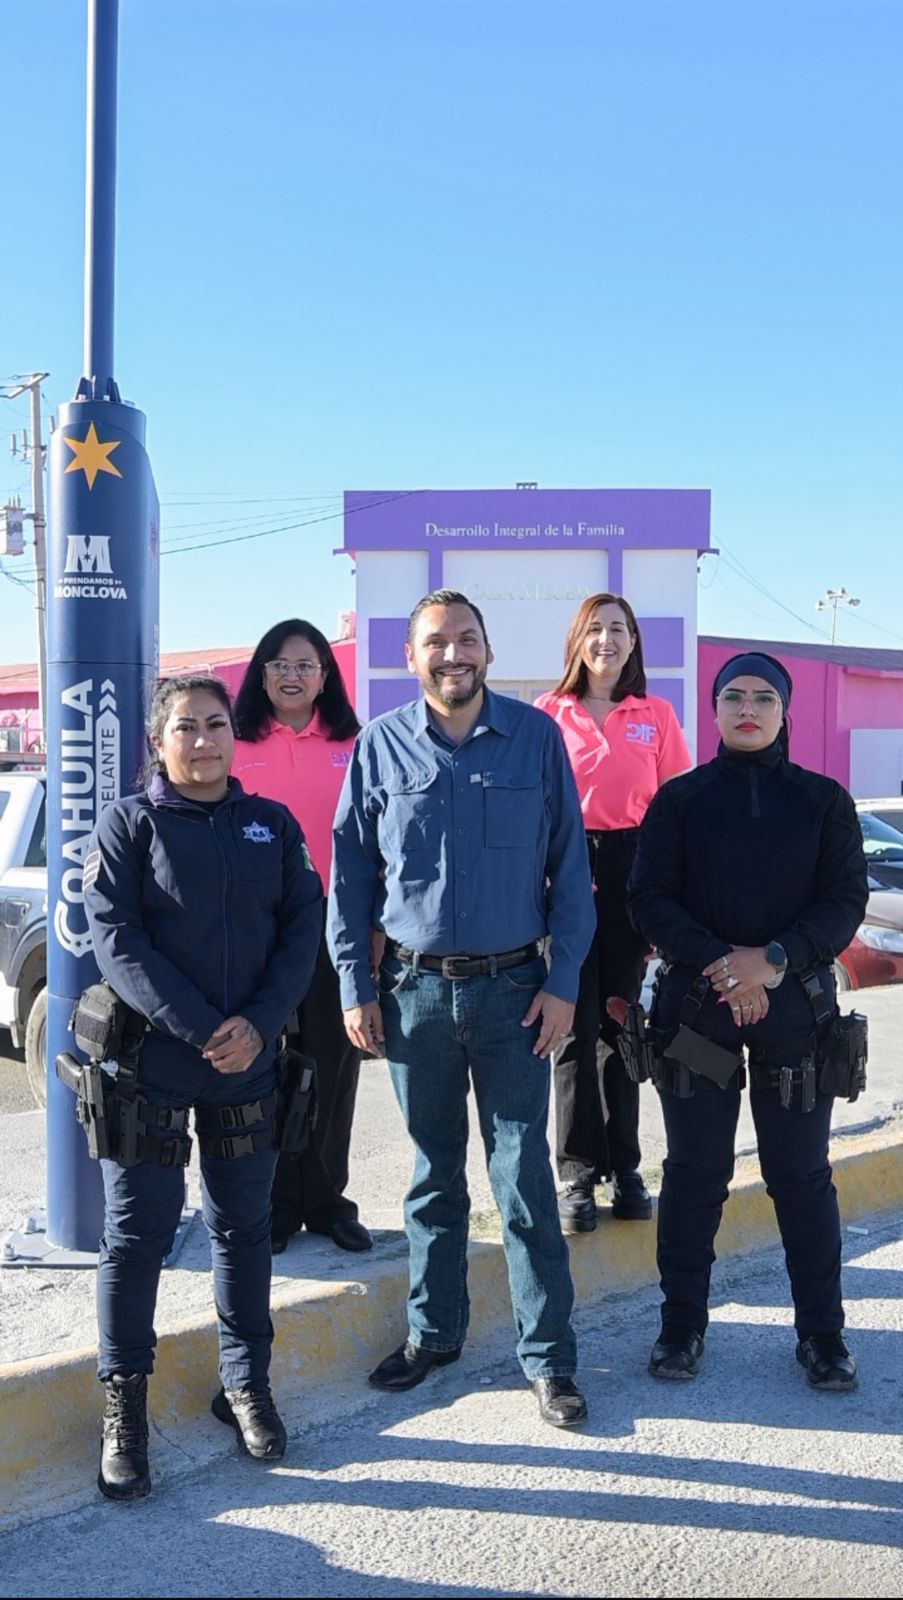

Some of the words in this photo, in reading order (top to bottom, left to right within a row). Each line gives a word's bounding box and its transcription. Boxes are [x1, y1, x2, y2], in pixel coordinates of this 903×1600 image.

[425, 522, 490, 537] Desarrollo
[494, 522, 540, 540] Integral
[544, 523, 559, 537] de
[562, 523, 574, 537] la
[577, 522, 625, 537] Familia
[64, 535, 114, 574] M
[63, 577, 114, 585] PRENDAMOS
[53, 585, 128, 600] MONCLOVA
[54, 678, 95, 958] COAHUILA
